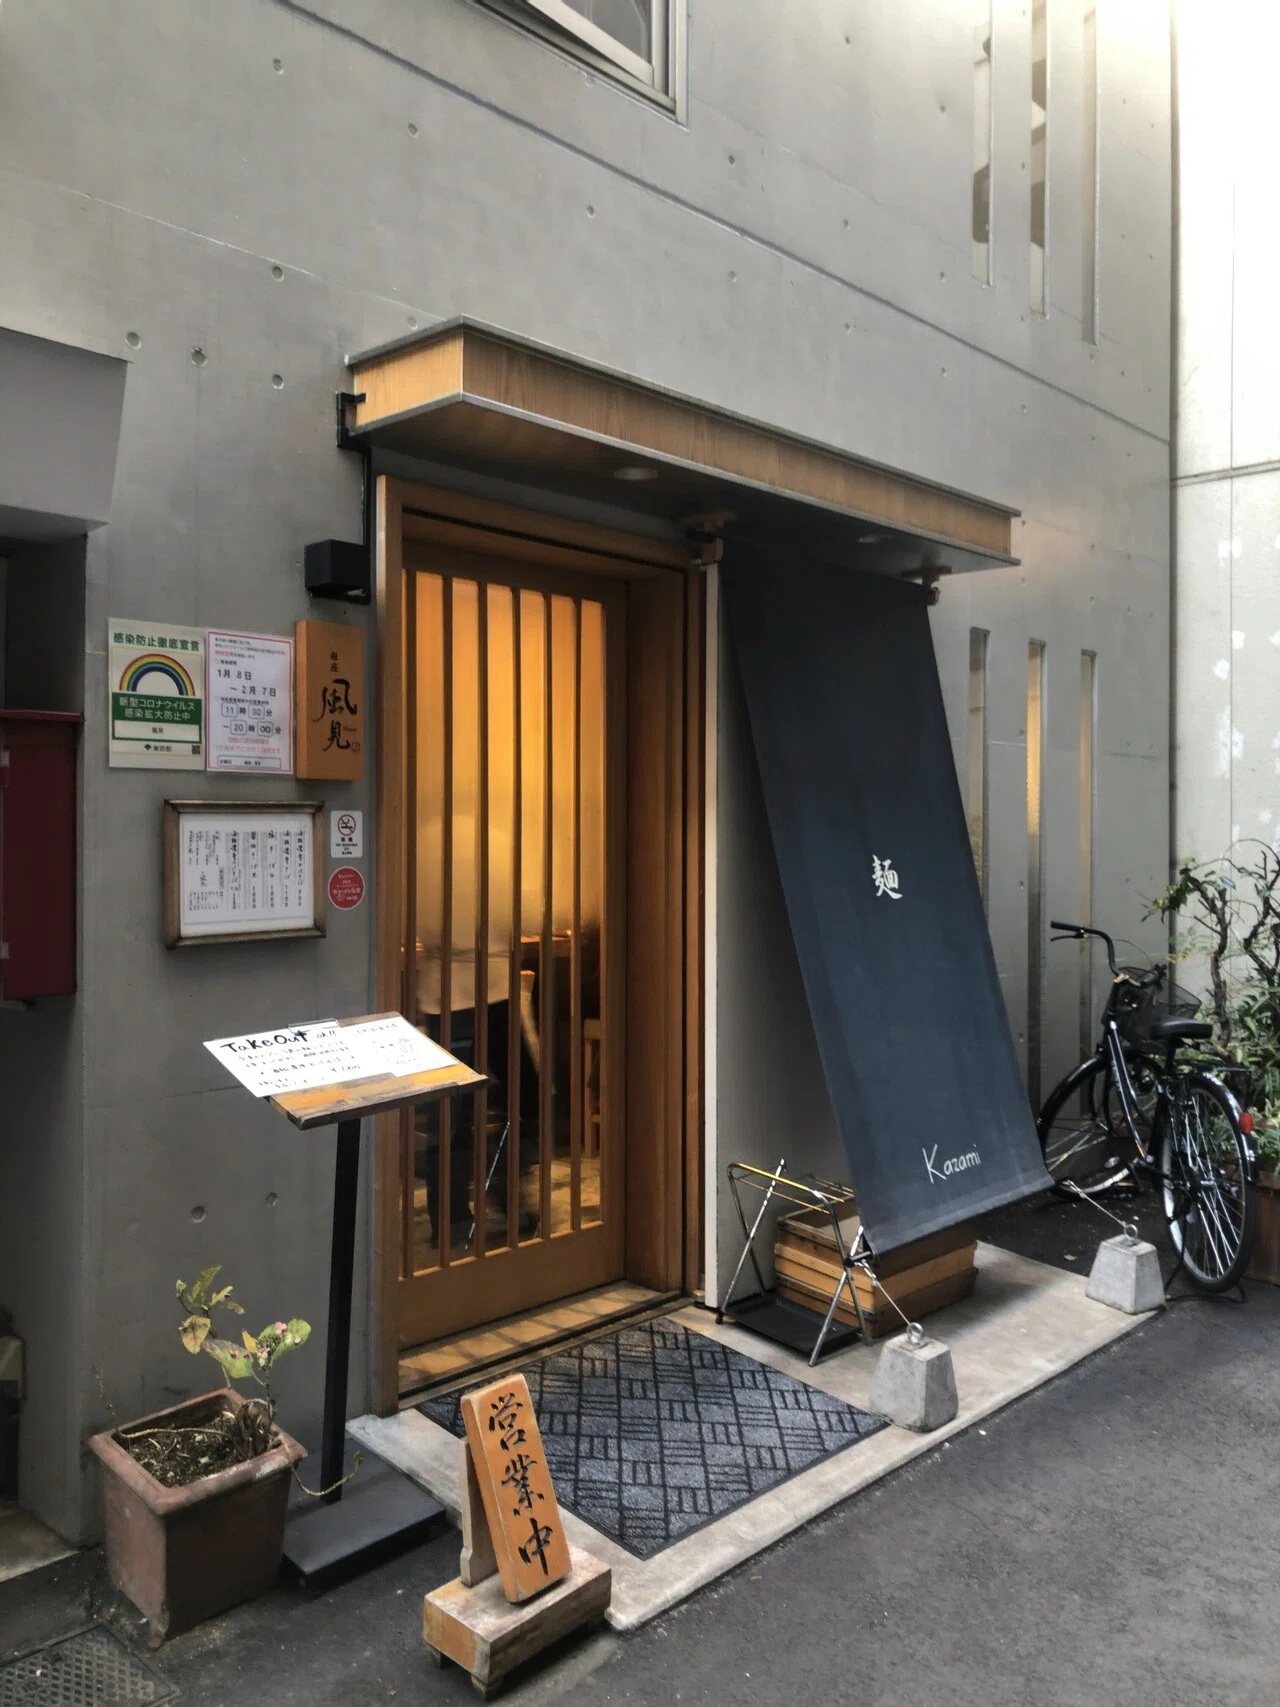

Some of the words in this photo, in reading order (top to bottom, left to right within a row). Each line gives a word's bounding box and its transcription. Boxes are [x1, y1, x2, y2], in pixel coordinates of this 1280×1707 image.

[113, 632, 200, 652] 感染防止徹底宣言
[119, 696, 196, 711] 新型コロナウイルス
[922, 1143, 983, 1185] Kazami
[488, 1392, 554, 1577] 営業中
